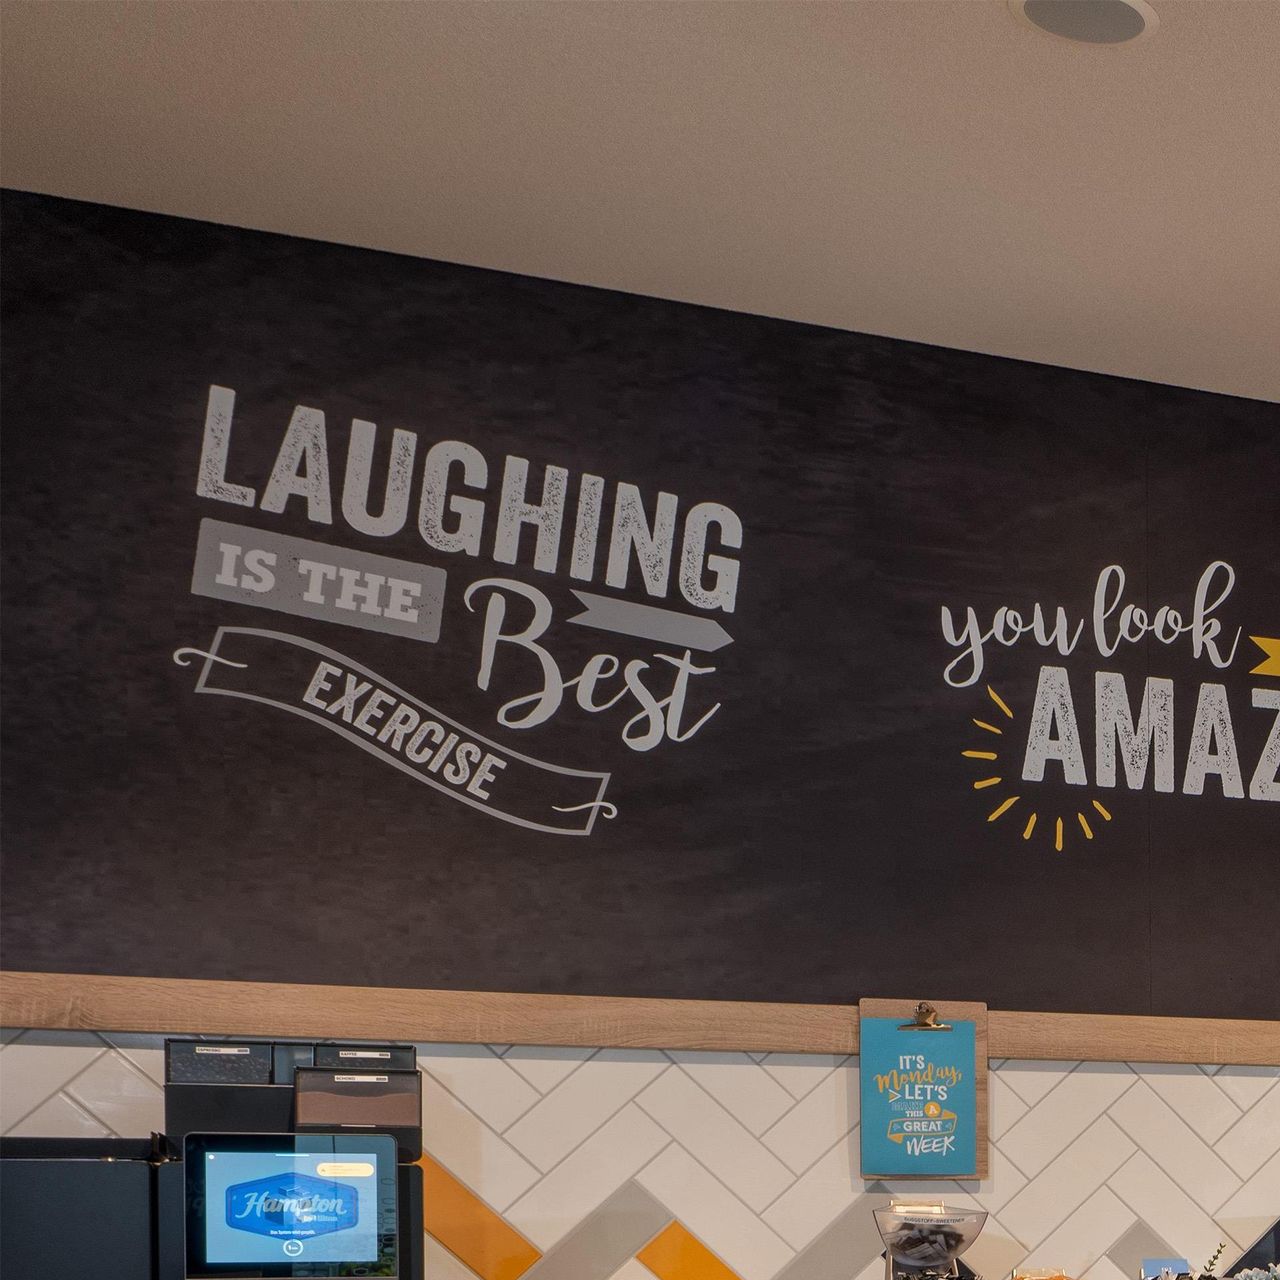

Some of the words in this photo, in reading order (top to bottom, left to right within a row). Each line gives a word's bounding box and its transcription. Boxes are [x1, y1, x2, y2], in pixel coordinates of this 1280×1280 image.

[196, 384, 742, 613] LAUGHING
[215, 542, 278, 594] IS
[298, 560, 422, 624] THE
[941, 602, 1084, 687] you
[1094, 561, 1242, 668] look
[463, 577, 721, 752] Best
[302, 661, 507, 800] EXERCISE
[899, 1055, 925, 1069] IT'S
[873, 1062, 962, 1093] Monday,
[905, 1084, 948, 1100] LET'S
[929, 1105, 937, 1114] A
[903, 1120, 943, 1132] GREAT
[906, 1135, 955, 1156] WEEK
[235, 1191, 348, 1218] Hampton
